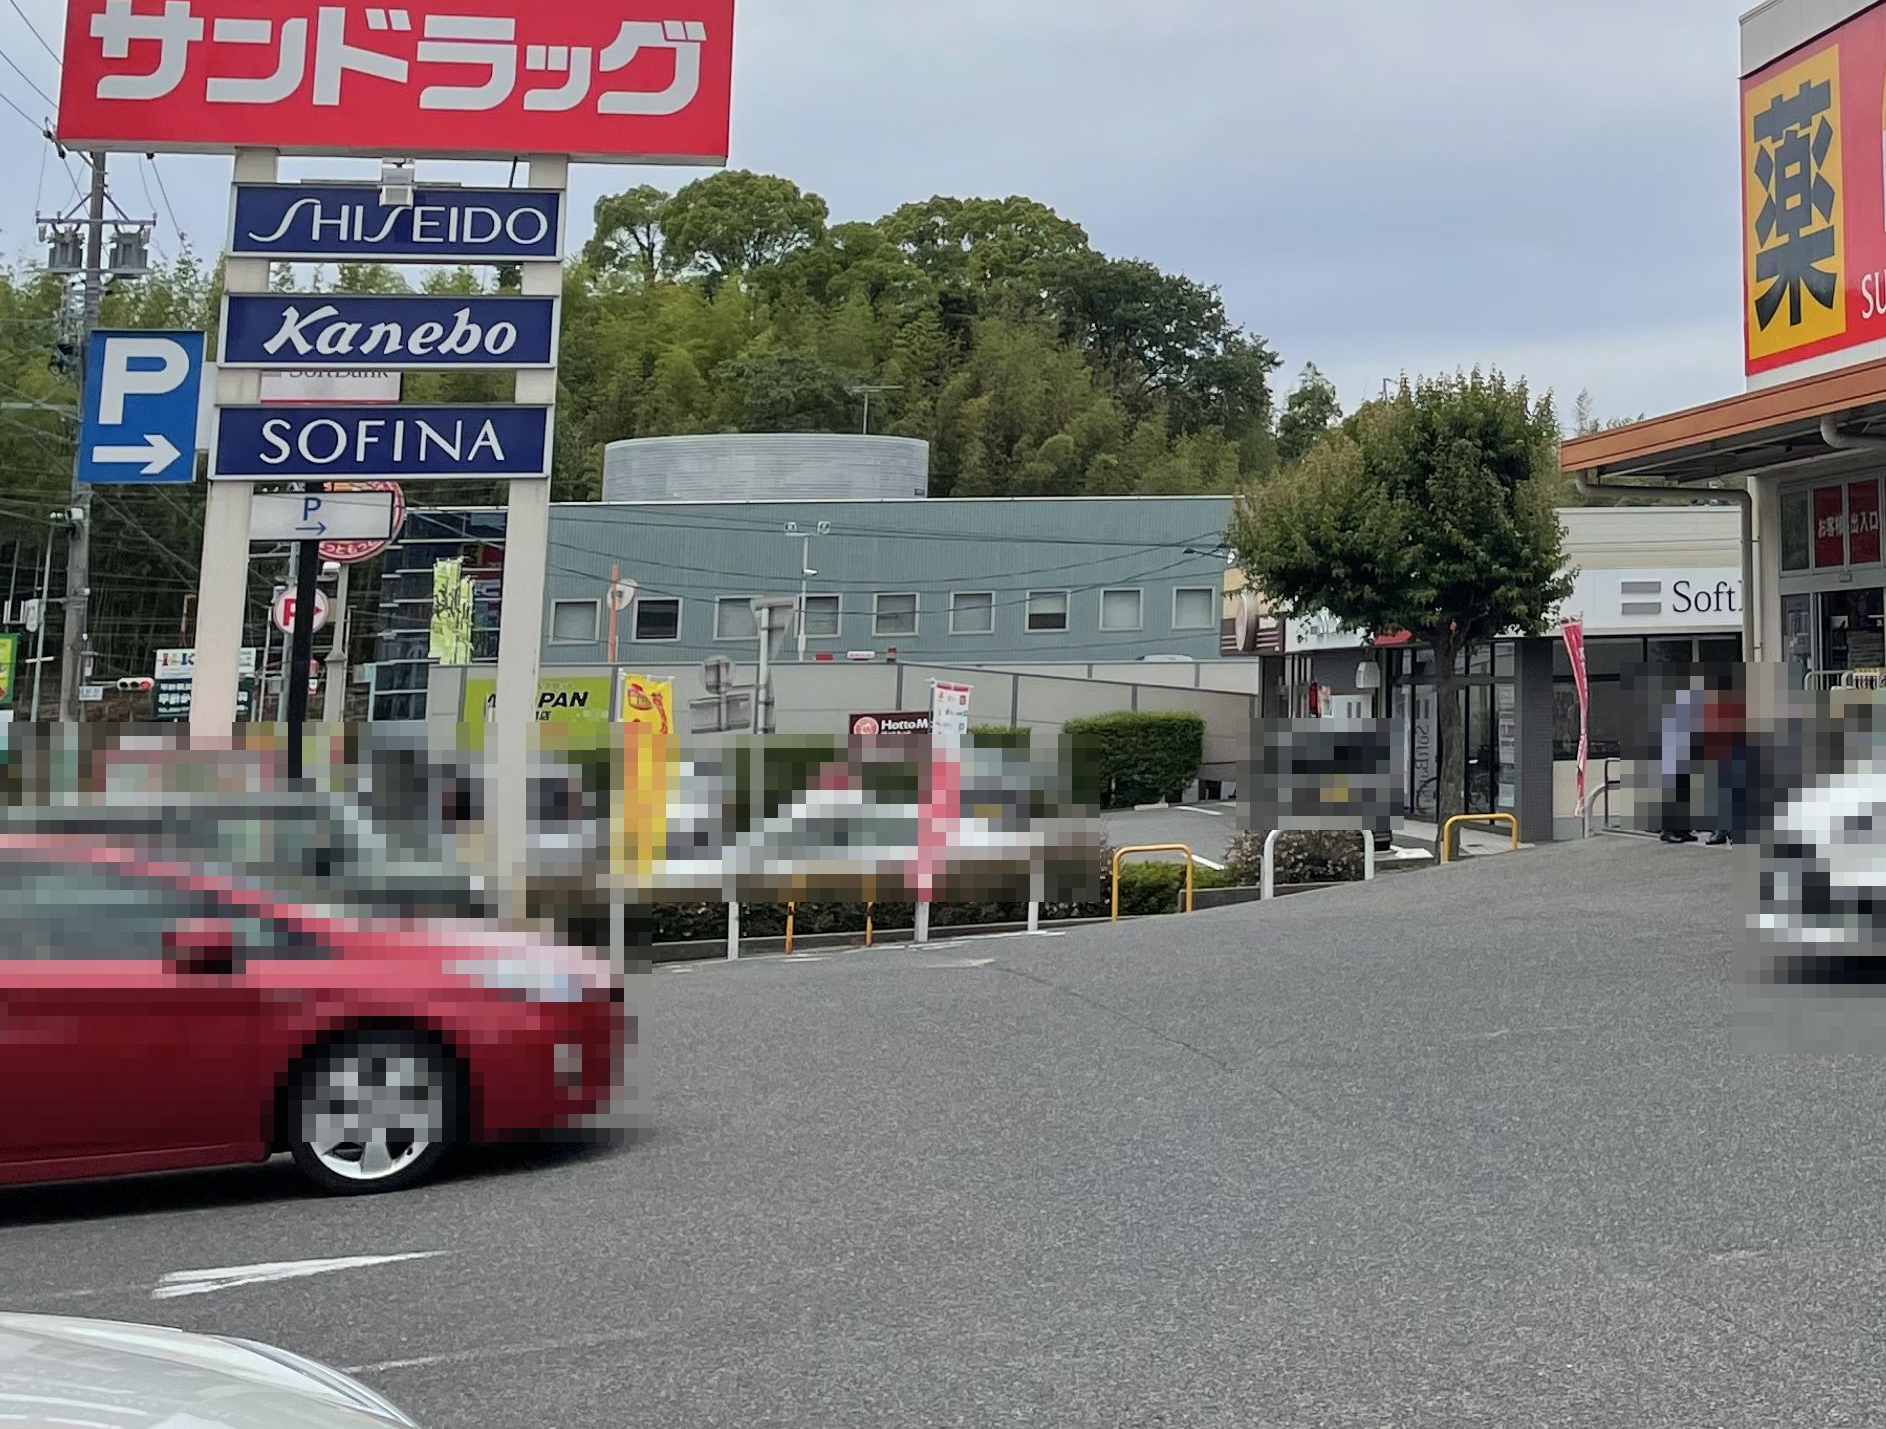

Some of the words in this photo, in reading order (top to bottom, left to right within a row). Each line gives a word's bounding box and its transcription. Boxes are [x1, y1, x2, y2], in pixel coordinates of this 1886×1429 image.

[249, 198, 549, 245] SHISEIDO
[1753, 79, 1837, 332] 薬
[263, 306, 517, 356] Kanebo
[98, 338, 189, 425] P
[259, 418, 505, 465] SOFINA
[303, 497, 321, 521] P
[1672, 580, 1743, 613] Soft
[881, 718, 933, 731] HottoM
